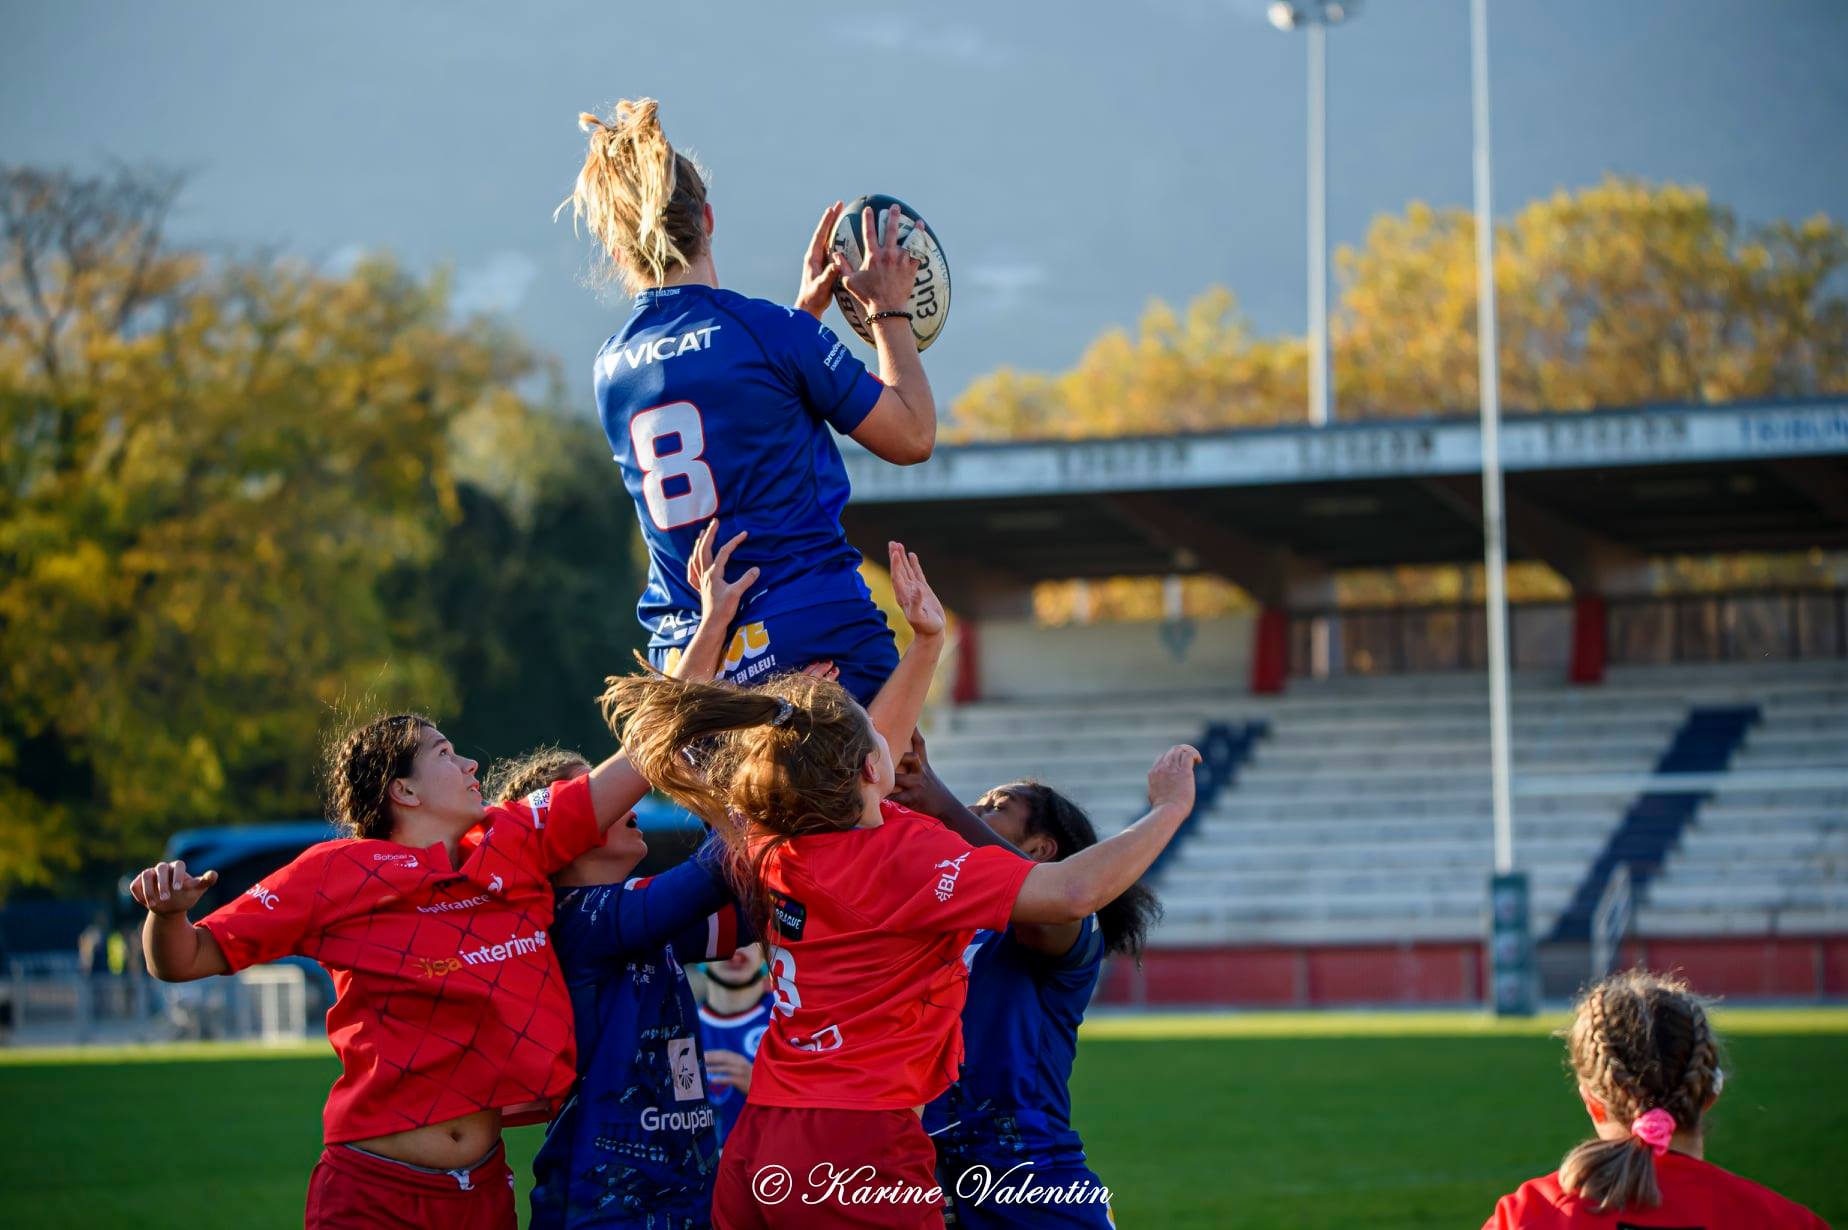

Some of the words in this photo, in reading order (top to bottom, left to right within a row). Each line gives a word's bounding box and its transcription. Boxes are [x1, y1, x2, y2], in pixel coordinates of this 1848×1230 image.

[623, 325, 721, 369] VICAT
[630, 400, 720, 531] 8
[747, 654, 777, 678] BLEU!
[416, 893, 493, 914] bpifrance
[458, 933, 537, 966] interim
